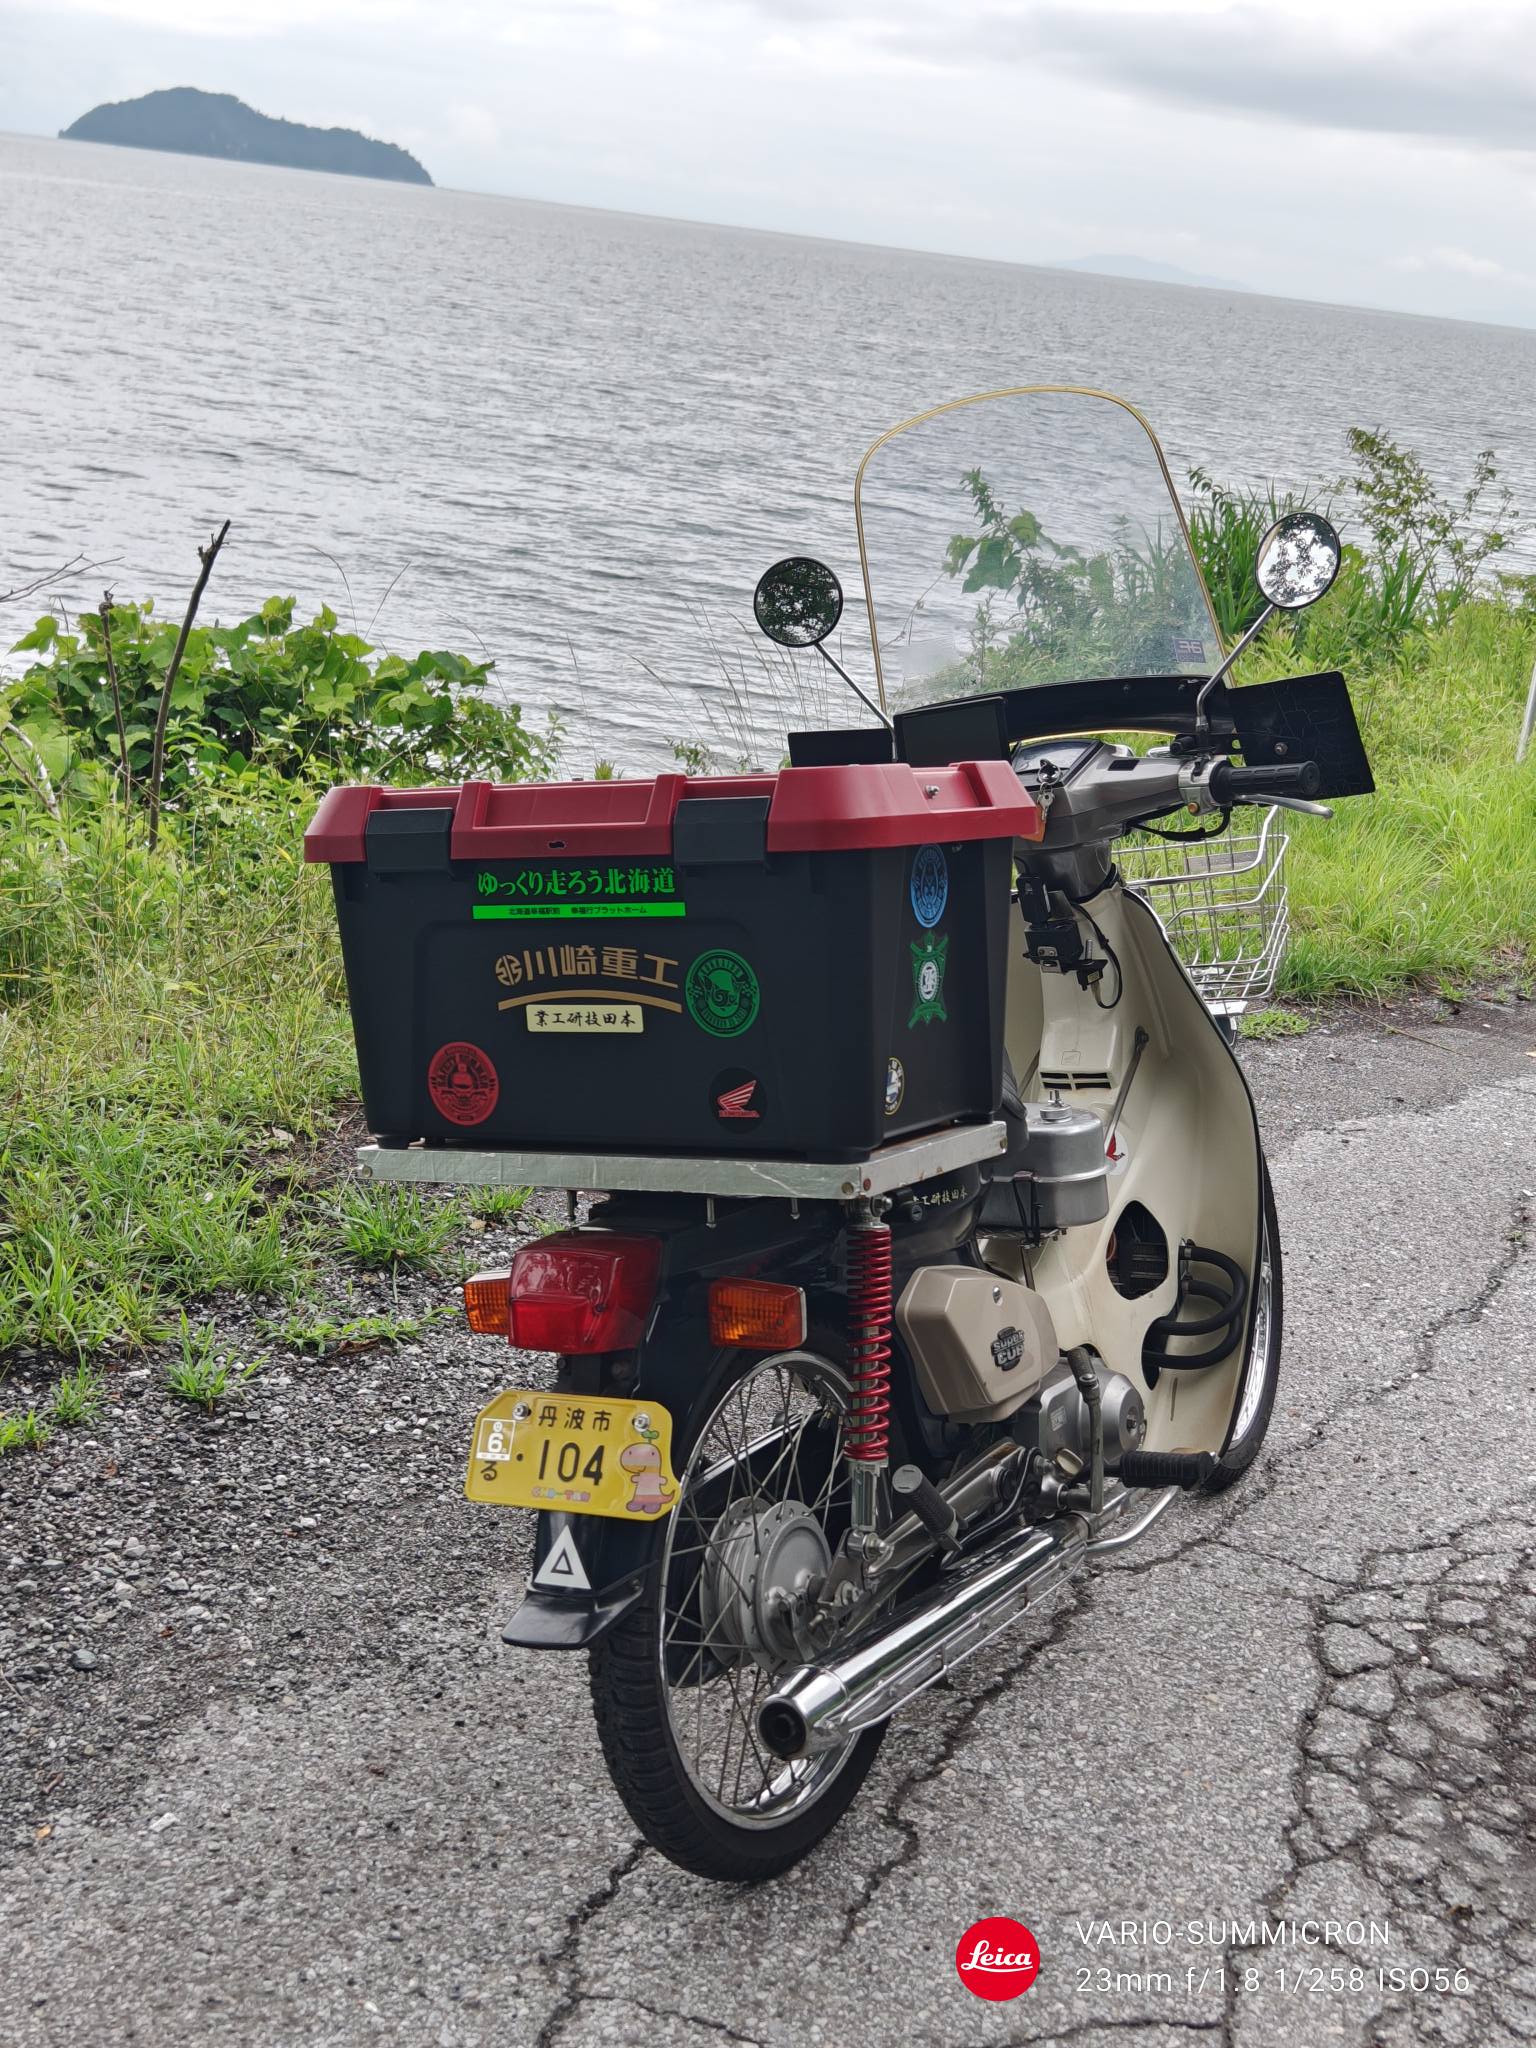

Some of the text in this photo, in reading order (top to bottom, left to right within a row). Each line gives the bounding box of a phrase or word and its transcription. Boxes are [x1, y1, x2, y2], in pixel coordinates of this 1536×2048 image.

[477, 867, 676, 896] ゆっくり走ろう北海道
[522, 944, 680, 989] 川崎重工
[538, 1405, 612, 1432] 丹波市
